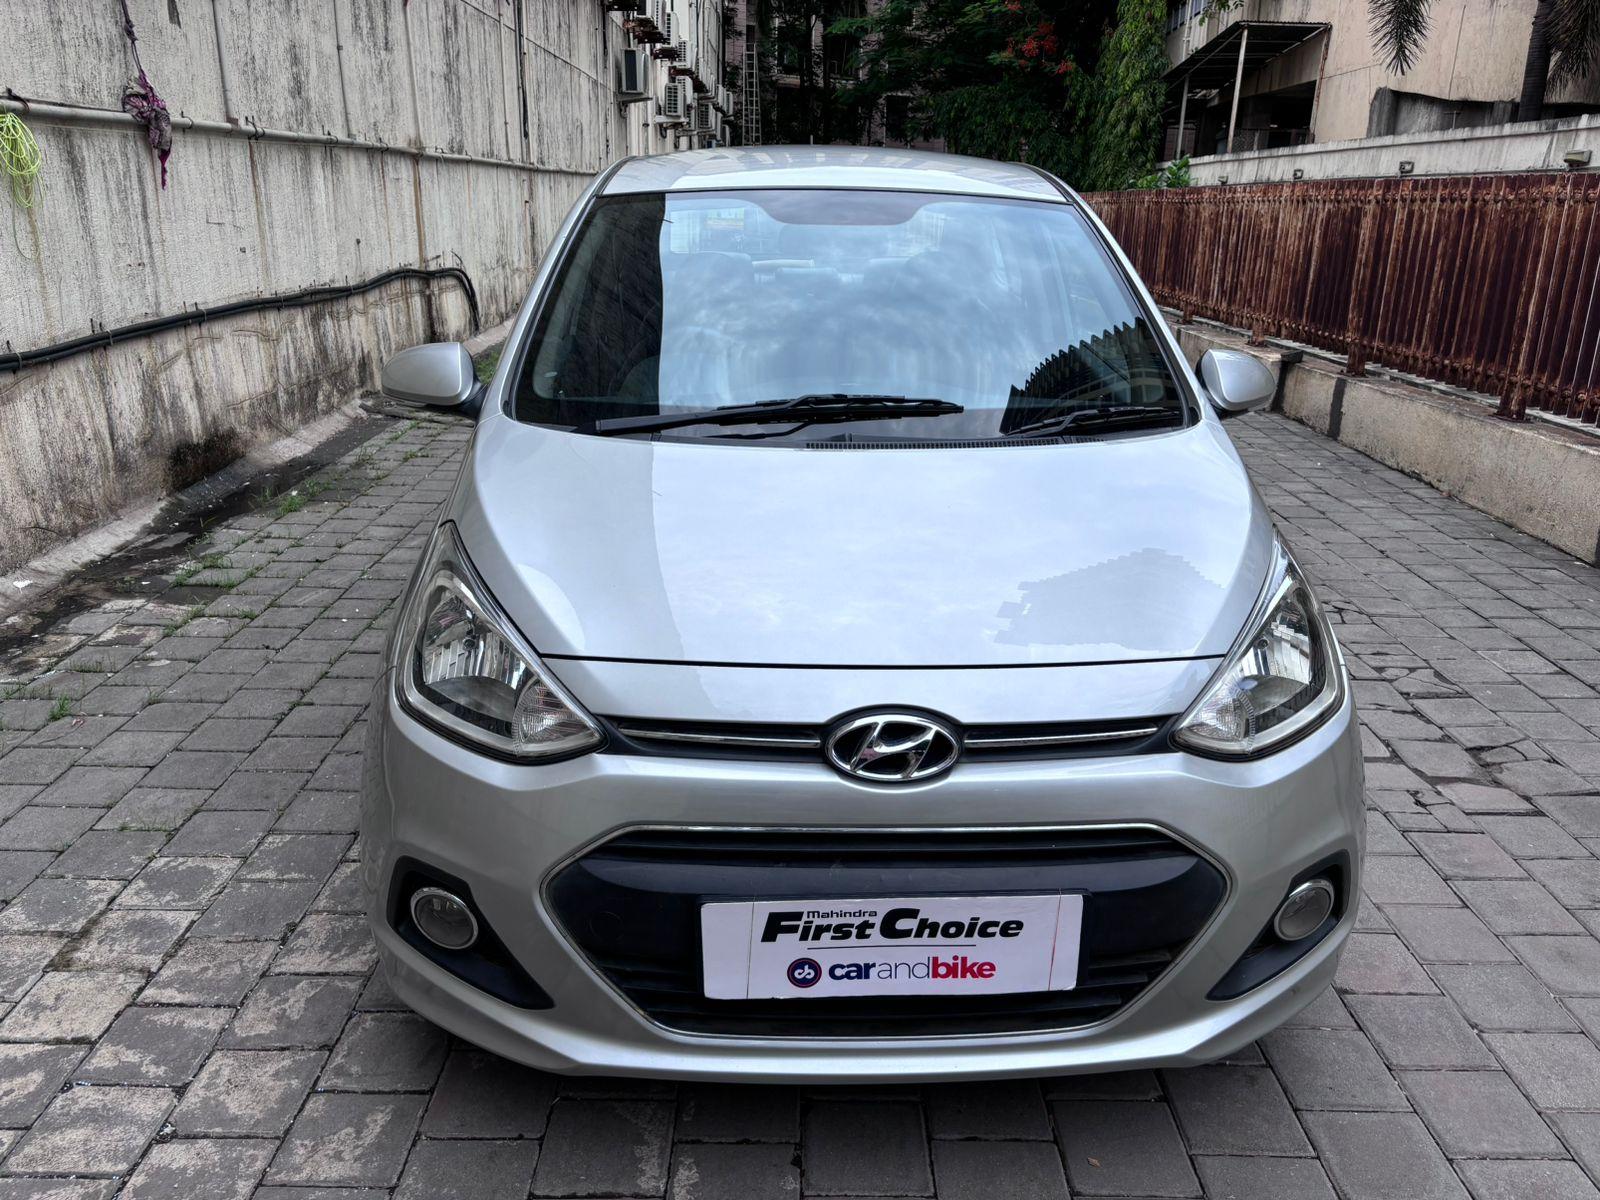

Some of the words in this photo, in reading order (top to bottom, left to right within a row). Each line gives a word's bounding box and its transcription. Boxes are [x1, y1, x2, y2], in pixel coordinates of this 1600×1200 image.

[760, 911, 876, 942] First
[879, 908, 1024, 939] Choice
[807, 909, 877, 919] Mahindra
[828, 955, 996, 980] carandbike
